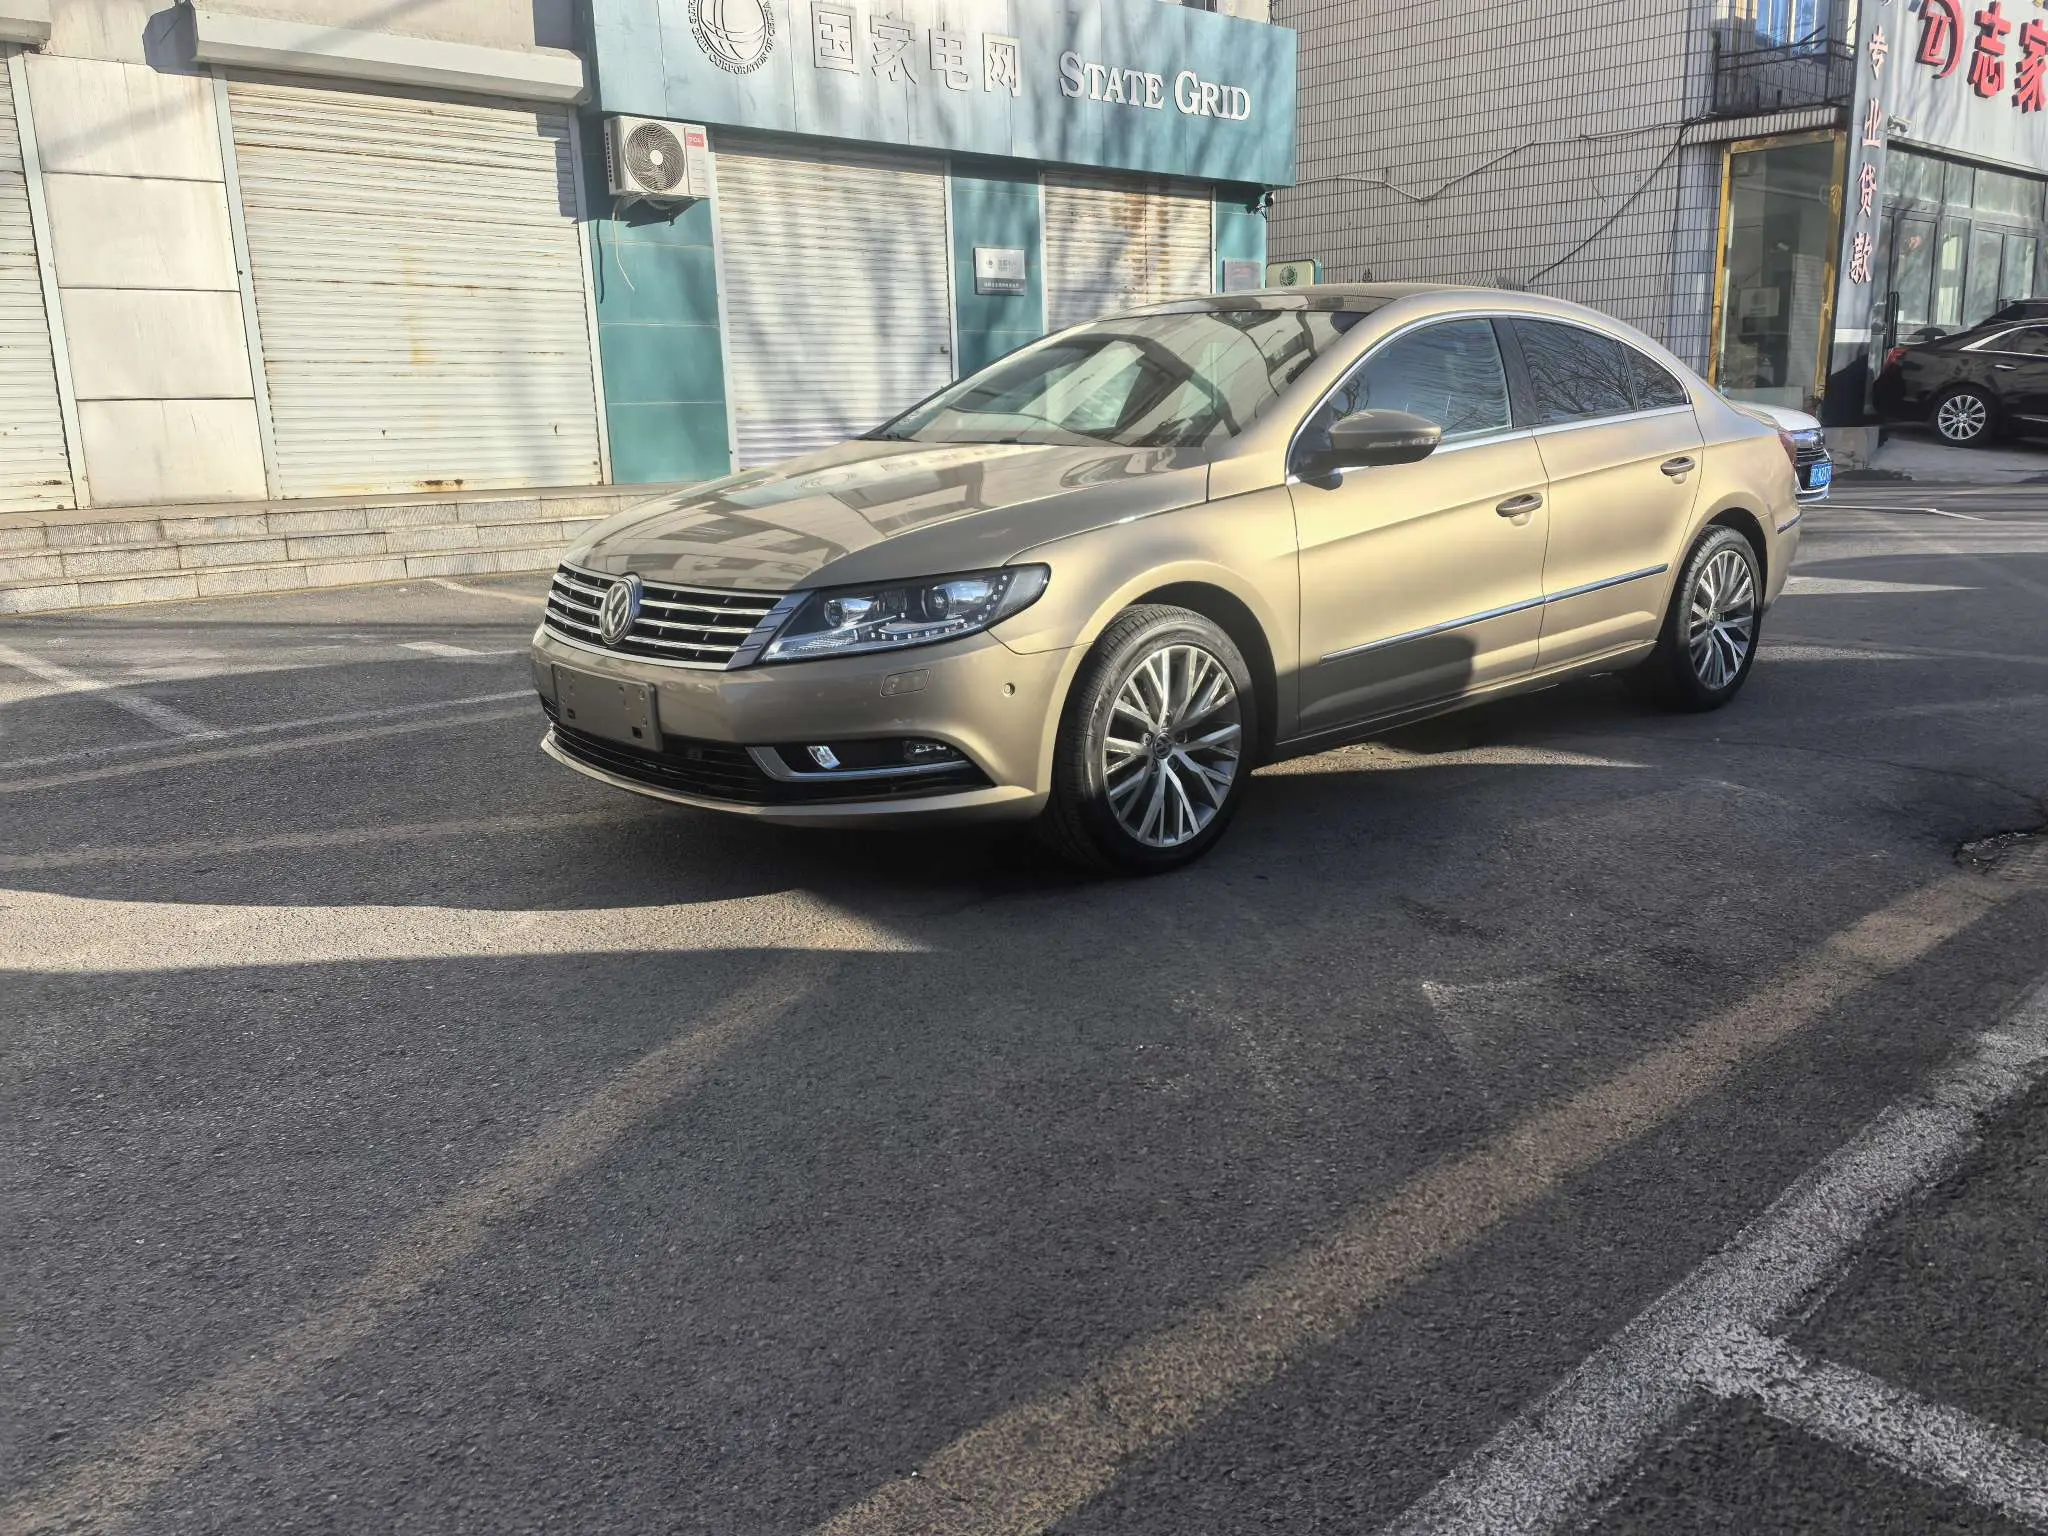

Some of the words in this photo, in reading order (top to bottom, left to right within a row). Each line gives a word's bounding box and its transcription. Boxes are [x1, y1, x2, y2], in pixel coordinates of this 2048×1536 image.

[811, 1, 1020, 97] 国家电网
[1059, 50, 1164, 110] STATE
[1174, 70, 1250, 121] GRID
[1850, 0, 1893, 285] 专业贷款
